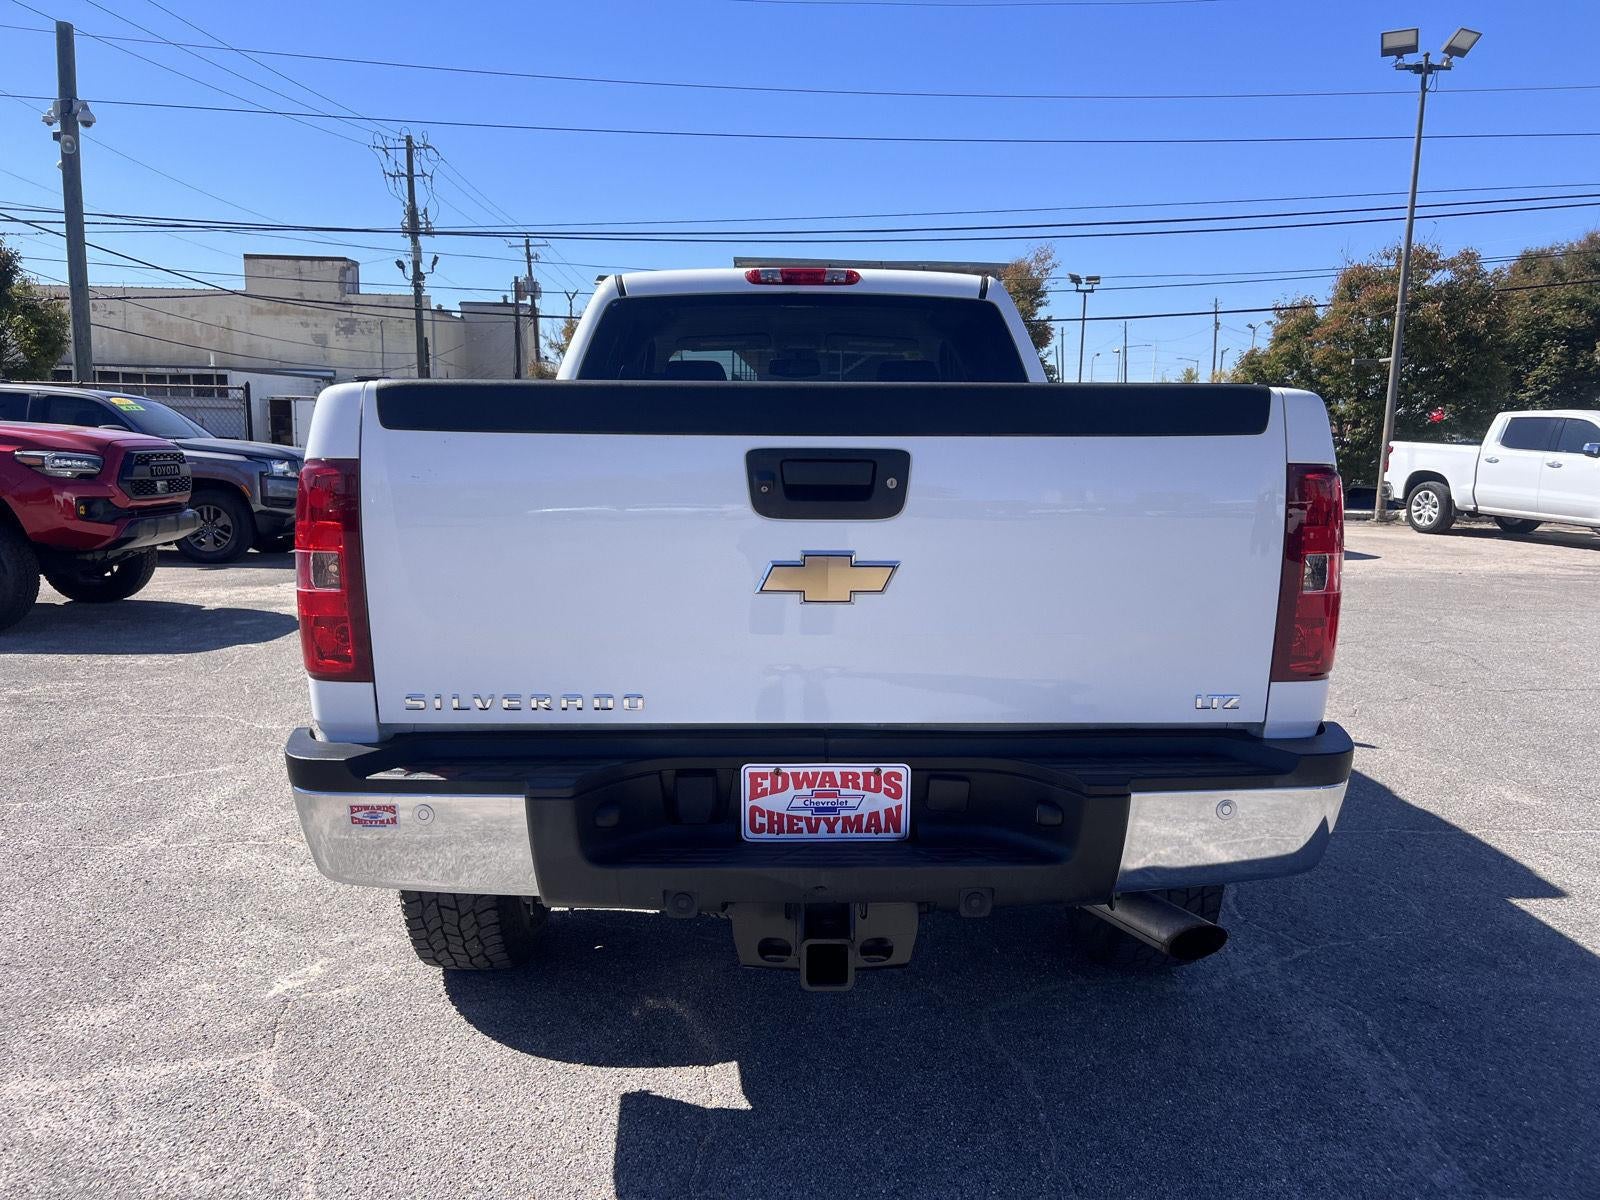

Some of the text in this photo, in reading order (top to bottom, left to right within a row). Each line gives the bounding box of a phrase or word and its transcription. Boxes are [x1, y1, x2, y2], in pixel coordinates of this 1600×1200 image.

[152, 465, 180, 476] TOYOTA
[404, 693, 645, 711] SILVERADO
[1195, 694, 1240, 710] LTZ
[749, 771, 903, 801] EDWARDS
[803, 799, 849, 807] Chevrolet
[350, 805, 397, 815] EDWARDS
[350, 815, 398, 825] CHEVYMAN
[749, 804, 903, 835] CHEVYMAN
